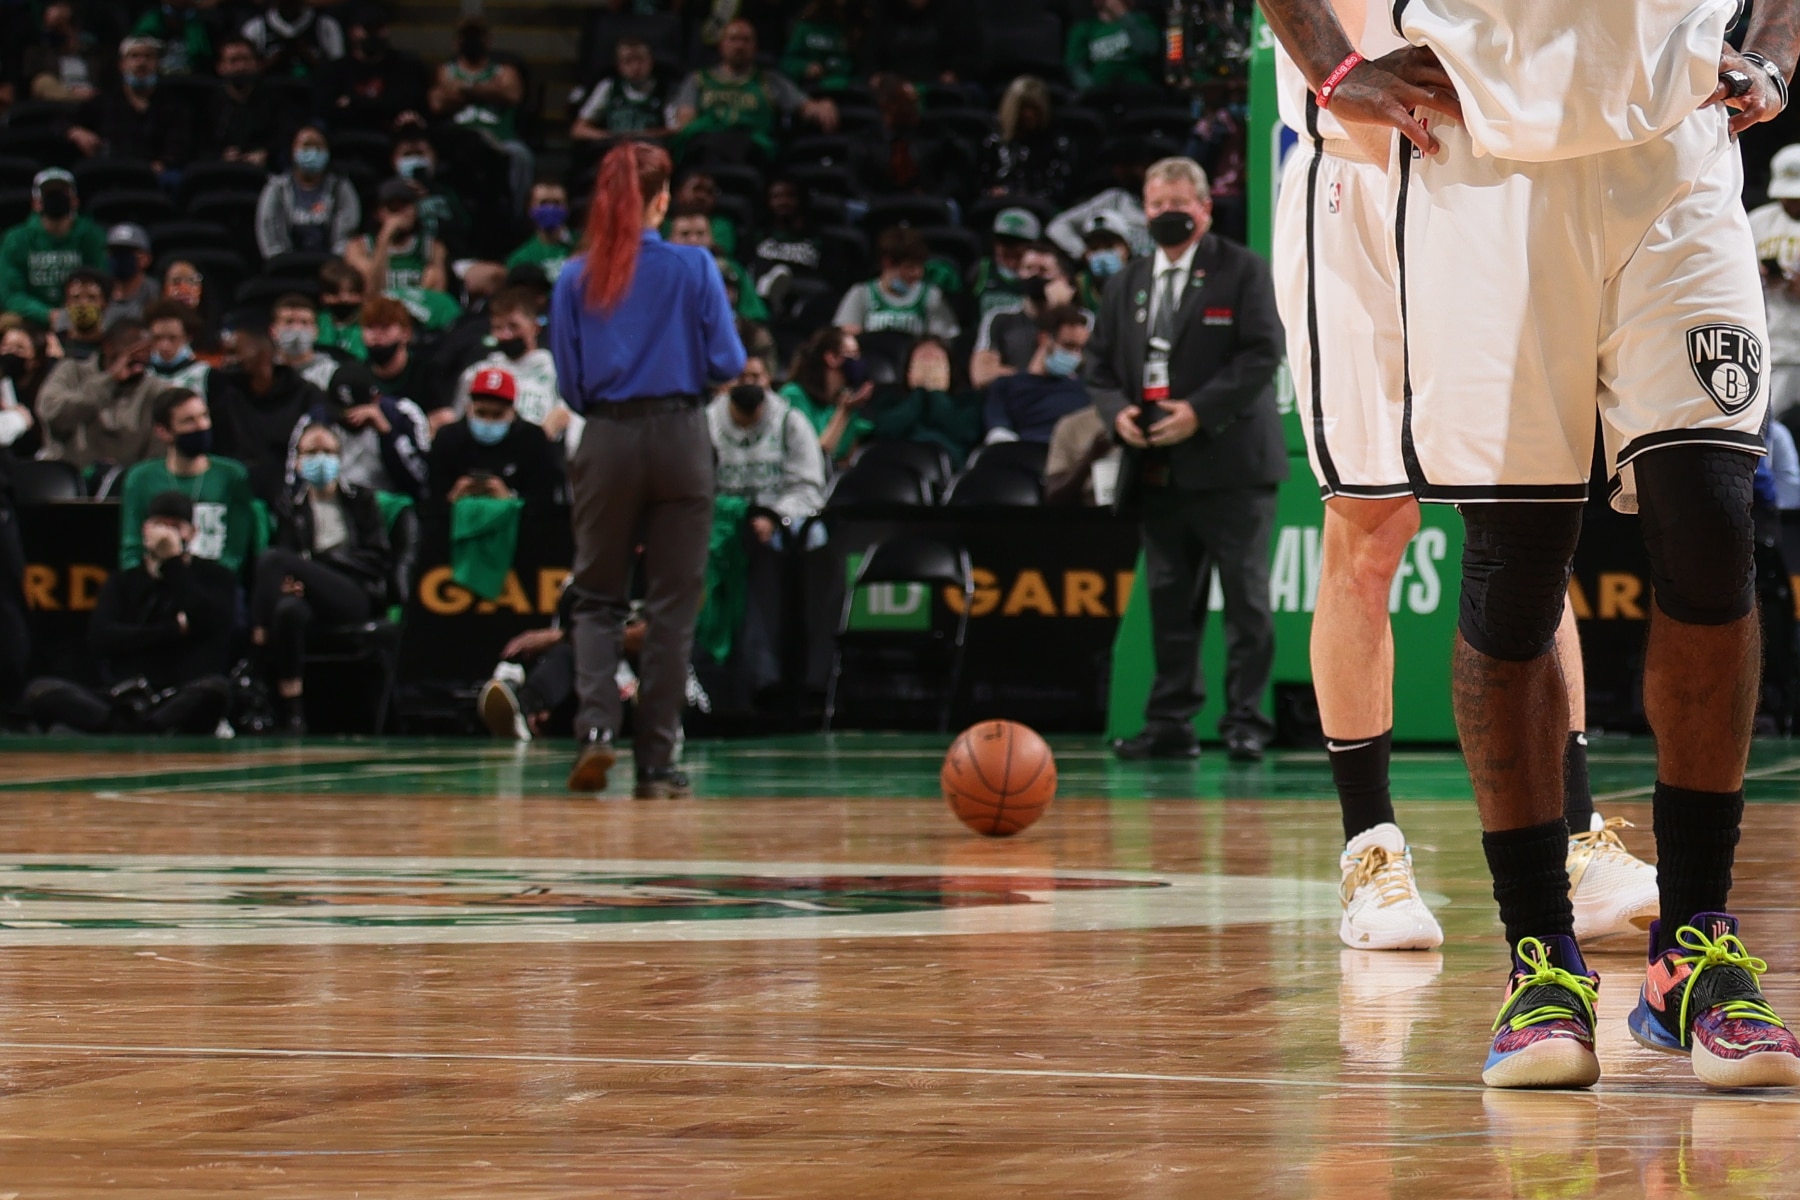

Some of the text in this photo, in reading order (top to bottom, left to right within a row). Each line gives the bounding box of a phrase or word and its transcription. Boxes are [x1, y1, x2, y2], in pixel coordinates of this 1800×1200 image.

[1695, 329, 1760, 374] NETS
[1726, 368, 1738, 399] B
[942, 568, 1137, 618] GAR
